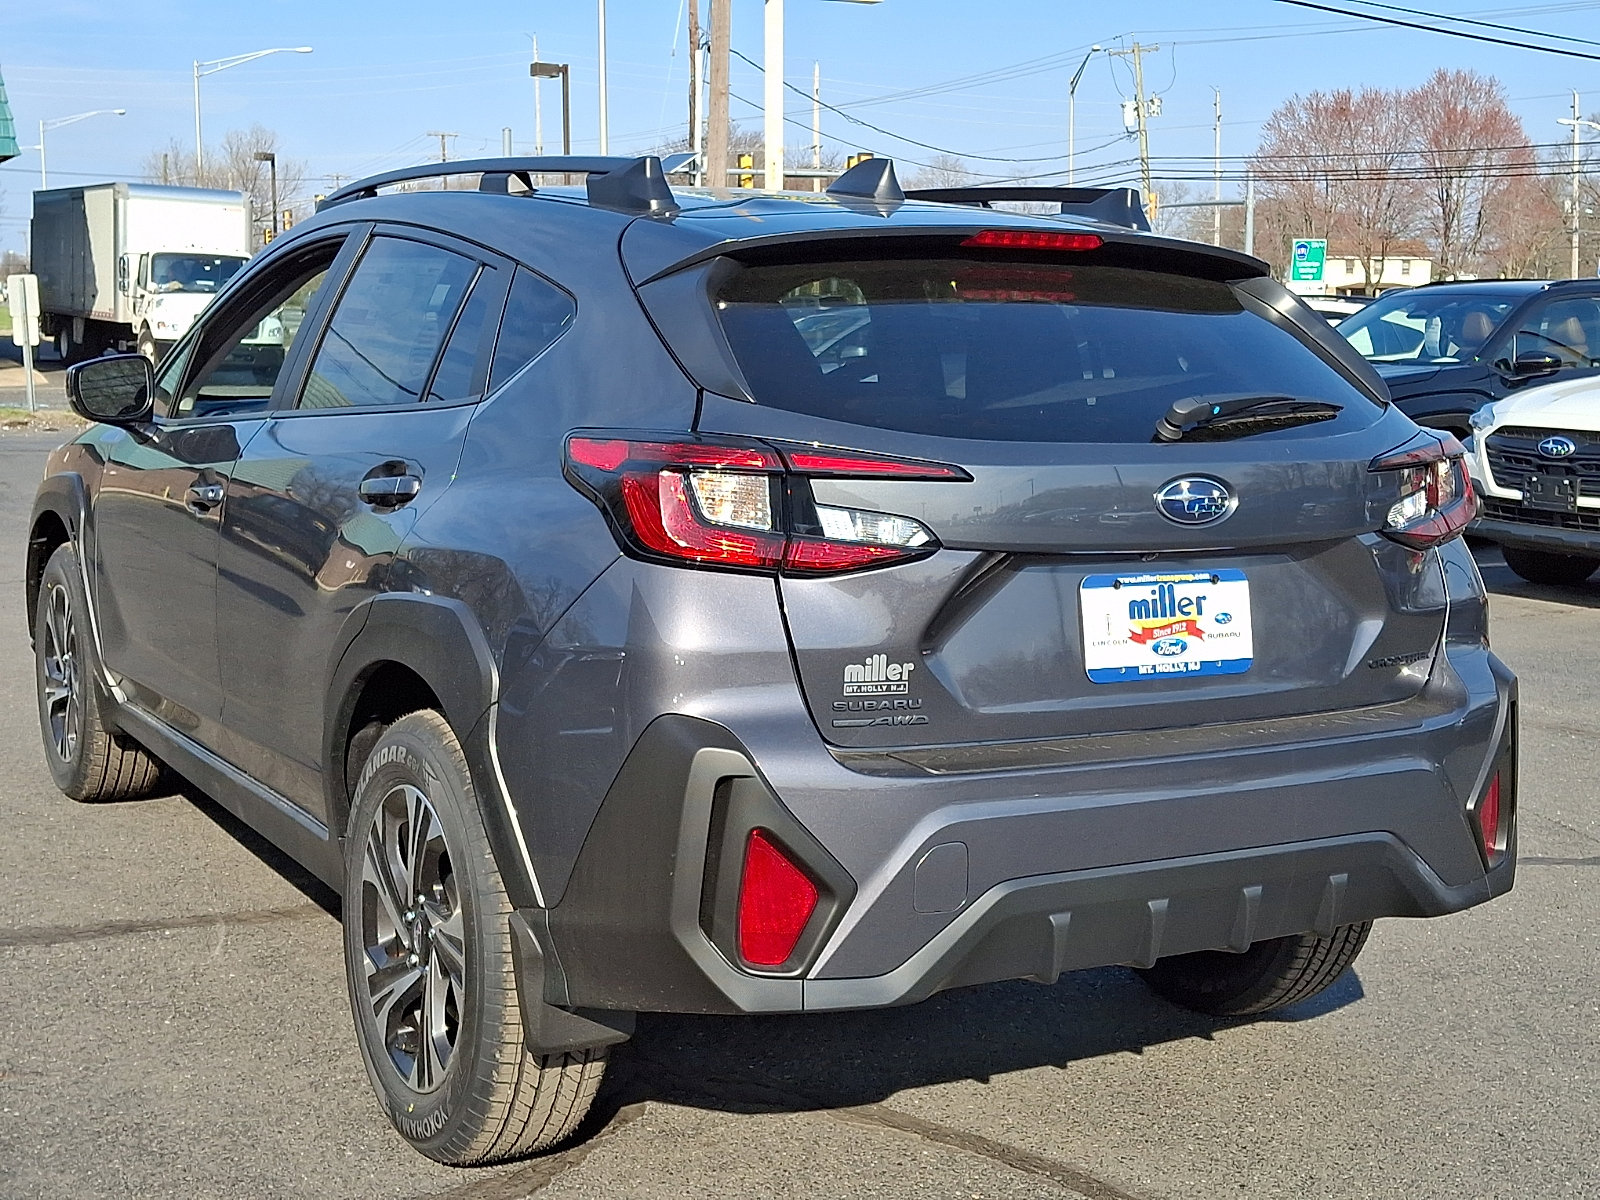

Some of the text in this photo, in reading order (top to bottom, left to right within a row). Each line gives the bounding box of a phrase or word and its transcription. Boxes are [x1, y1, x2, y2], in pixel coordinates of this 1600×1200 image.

[1129, 584, 1206, 620] miller
[1153, 622, 1187, 638] Since 1912
[1092, 639, 1128, 647] LINCOLN
[1158, 640, 1183, 655] Ford
[844, 654, 915, 682] miller
[1138, 661, 1201, 675] MT. HOLLY, NJ
[861, 685, 888, 693] HOLLY
[832, 698, 922, 712] SUBARU
[870, 714, 929, 726] AWD
[395, 1104, 449, 1139] YOKOHAMA
